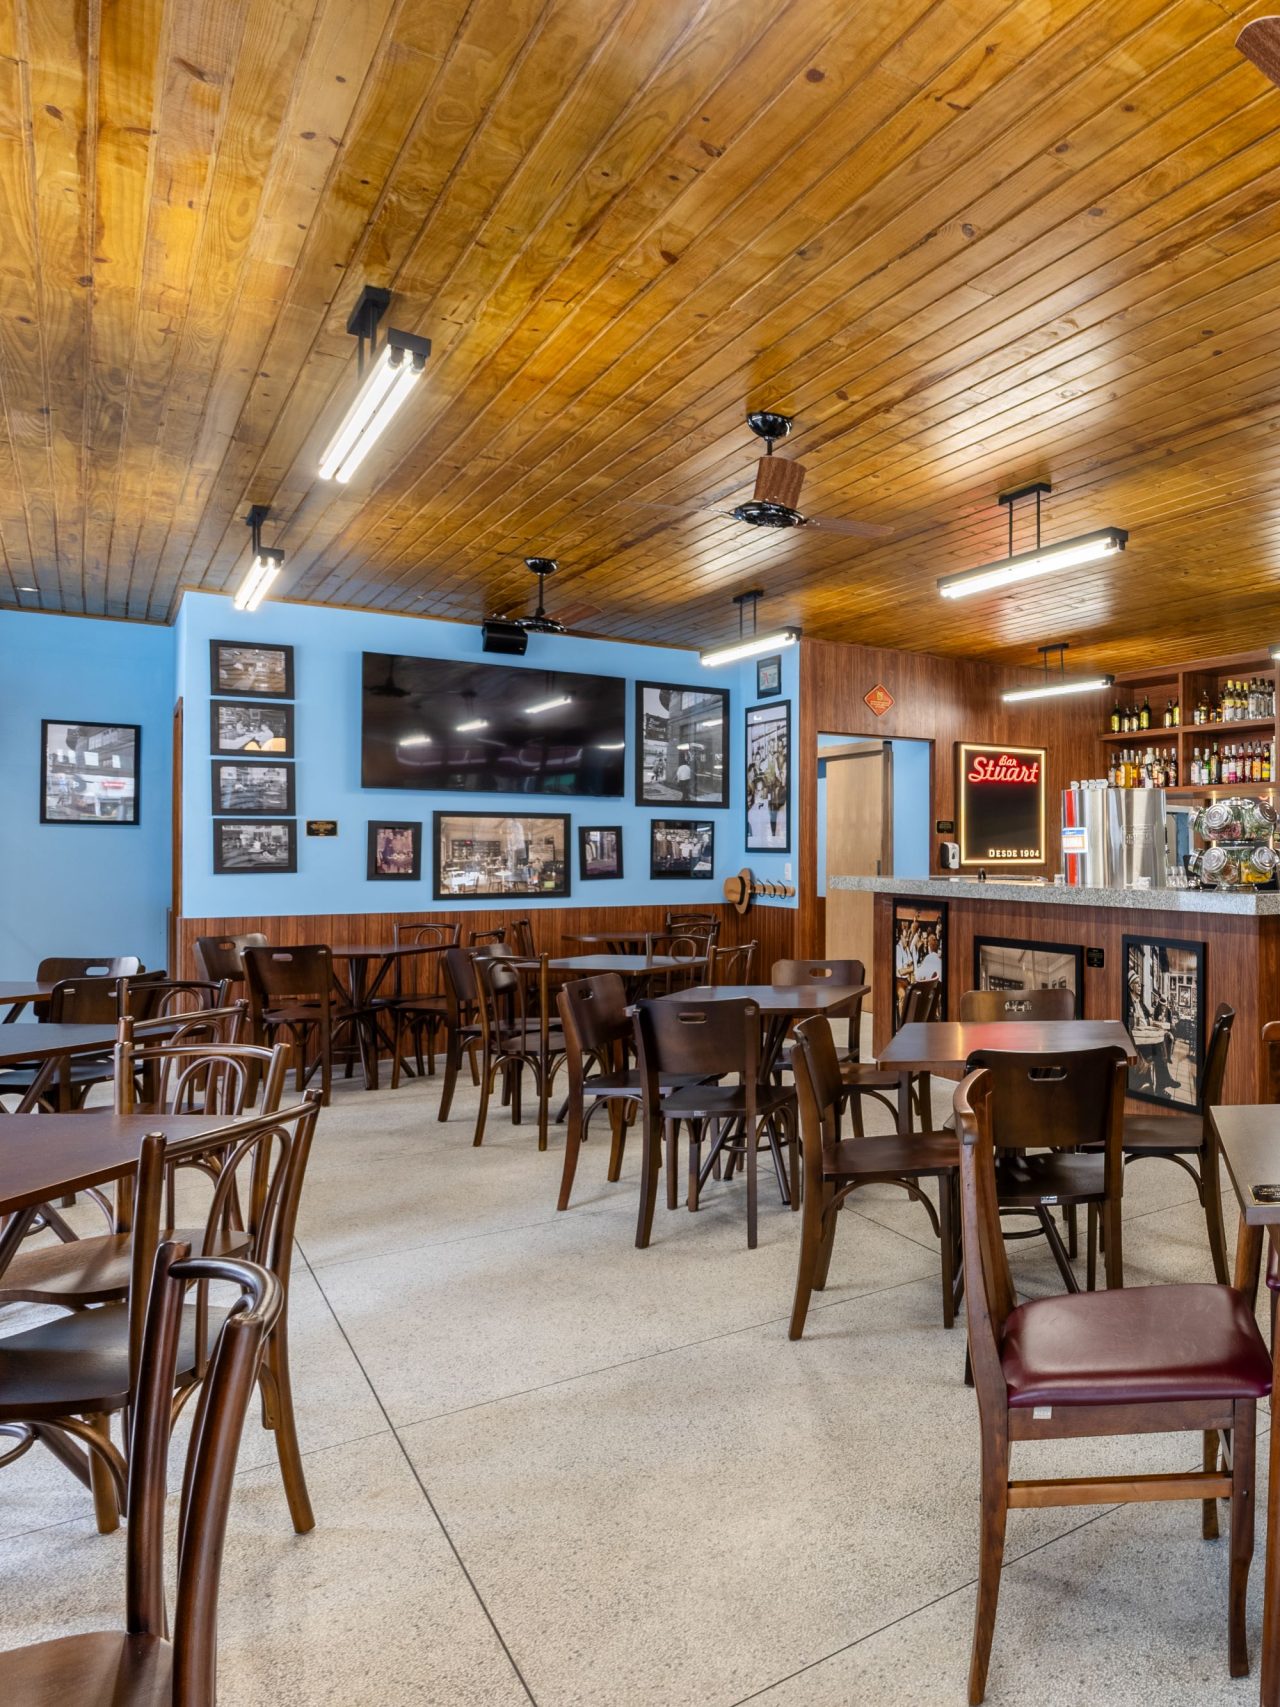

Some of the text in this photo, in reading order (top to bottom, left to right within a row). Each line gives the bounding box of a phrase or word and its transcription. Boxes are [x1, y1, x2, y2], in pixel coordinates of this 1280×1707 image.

[999, 755, 1017, 766] Bar
[968, 756, 1038, 783] Stuart
[988, 849, 1040, 858] DESDE 1904
